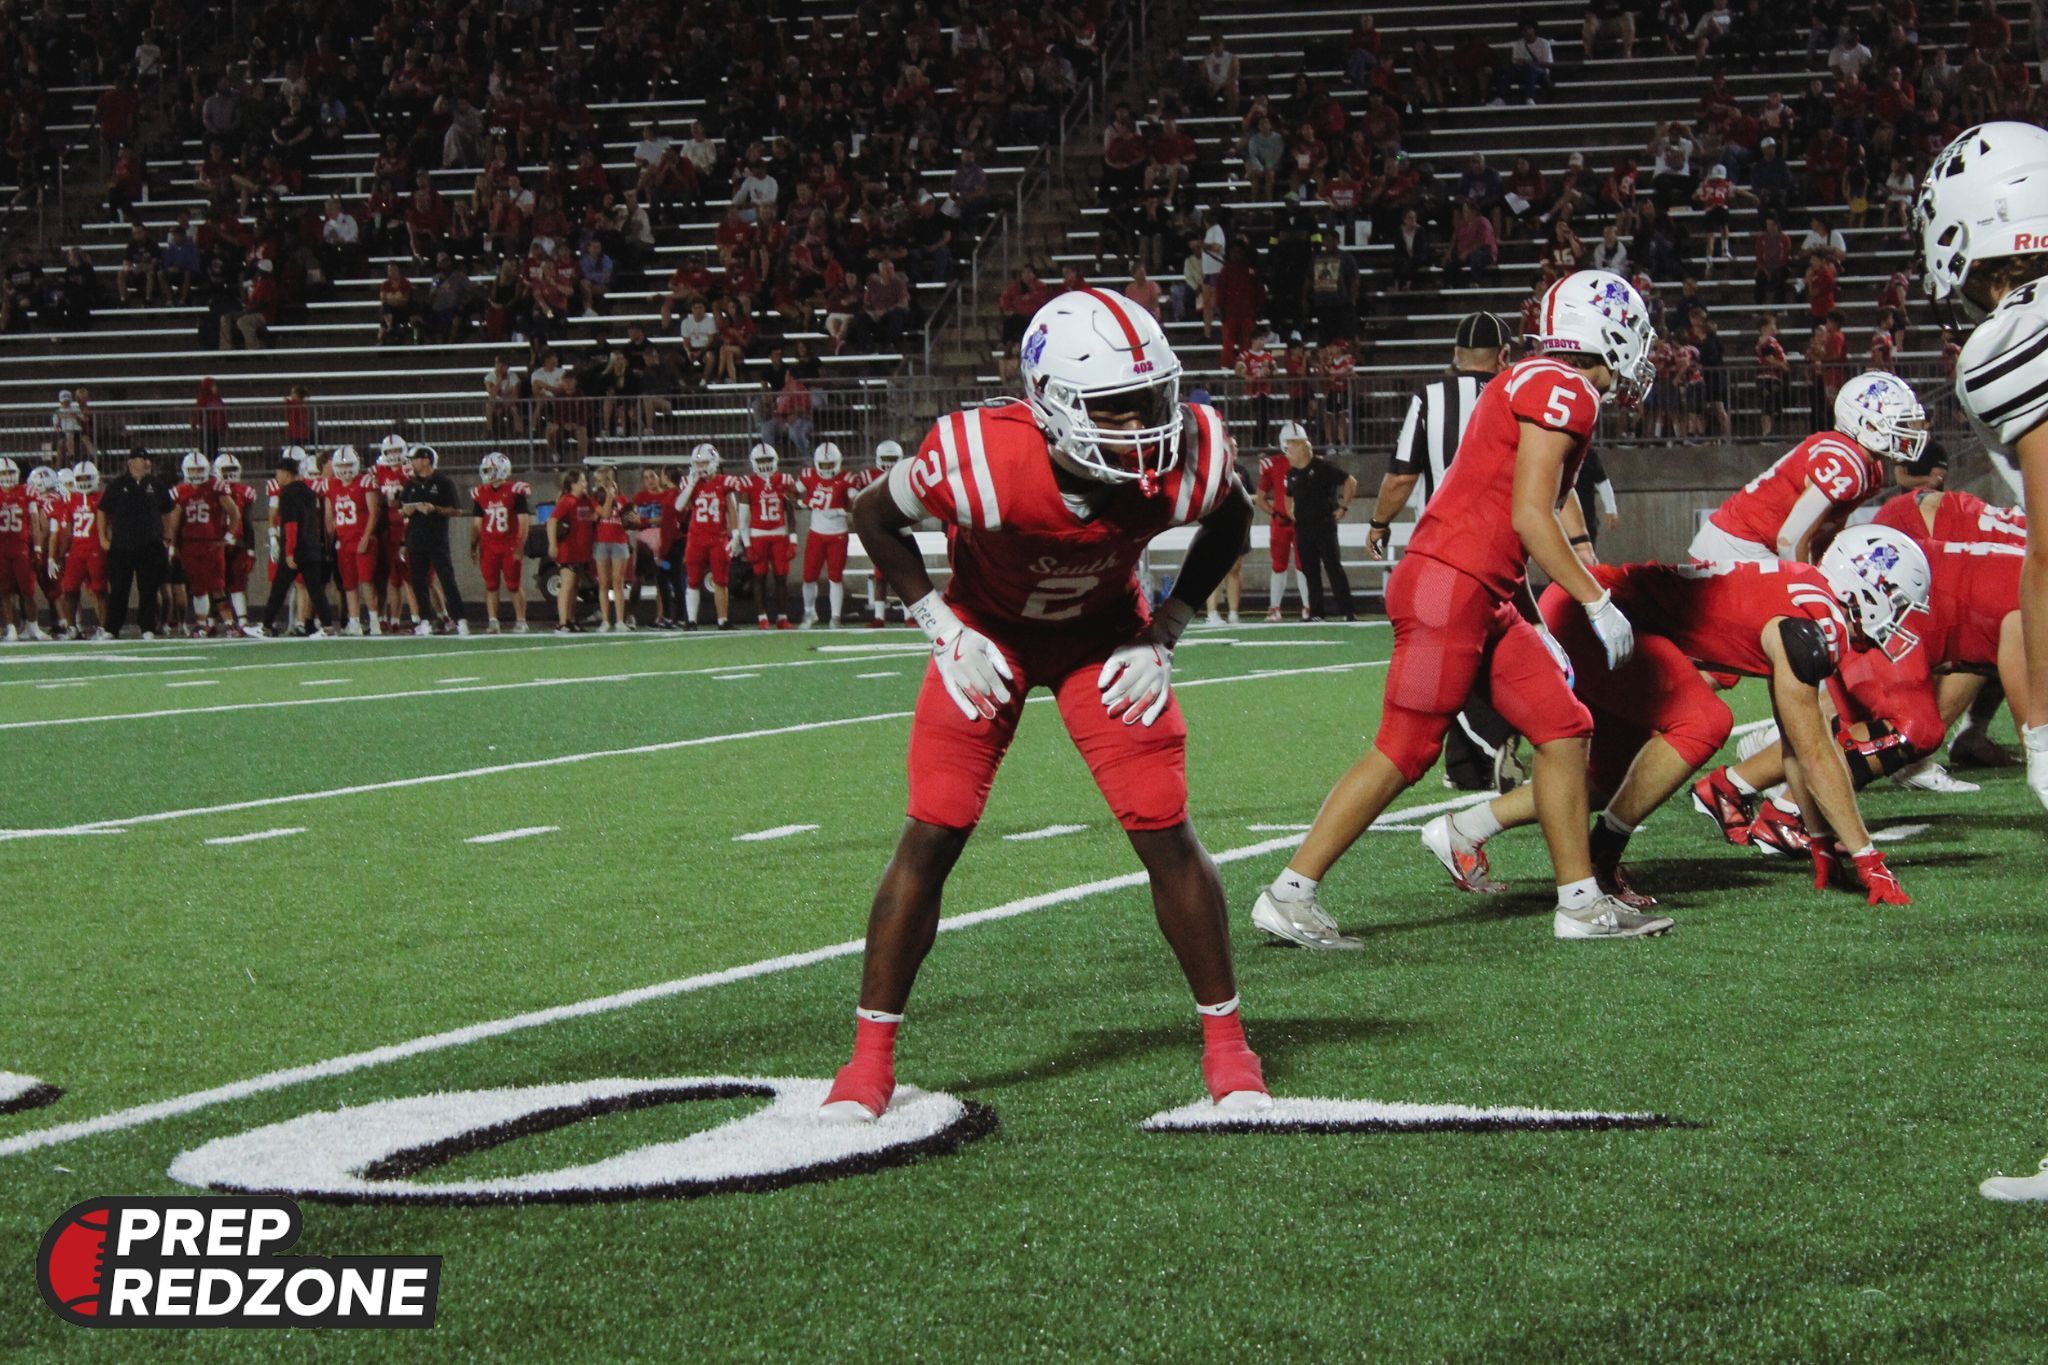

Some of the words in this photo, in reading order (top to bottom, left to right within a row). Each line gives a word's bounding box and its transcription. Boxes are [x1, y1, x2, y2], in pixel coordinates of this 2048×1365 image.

[1133, 361, 1154, 374] 402
[1543, 385, 1577, 427] 5
[911, 450, 943, 498] 2
[1815, 458, 1852, 499] 34
[335, 501, 357, 525] 63
[695, 497, 720, 523] 24
[760, 497, 781, 521] 12
[809, 490, 833, 511] 21
[0, 508, 23, 532] 35
[73, 512, 95, 537] 27
[485, 507, 508, 533] 78
[1029, 551, 1121, 575] South
[1020, 576, 1100, 620] 2
